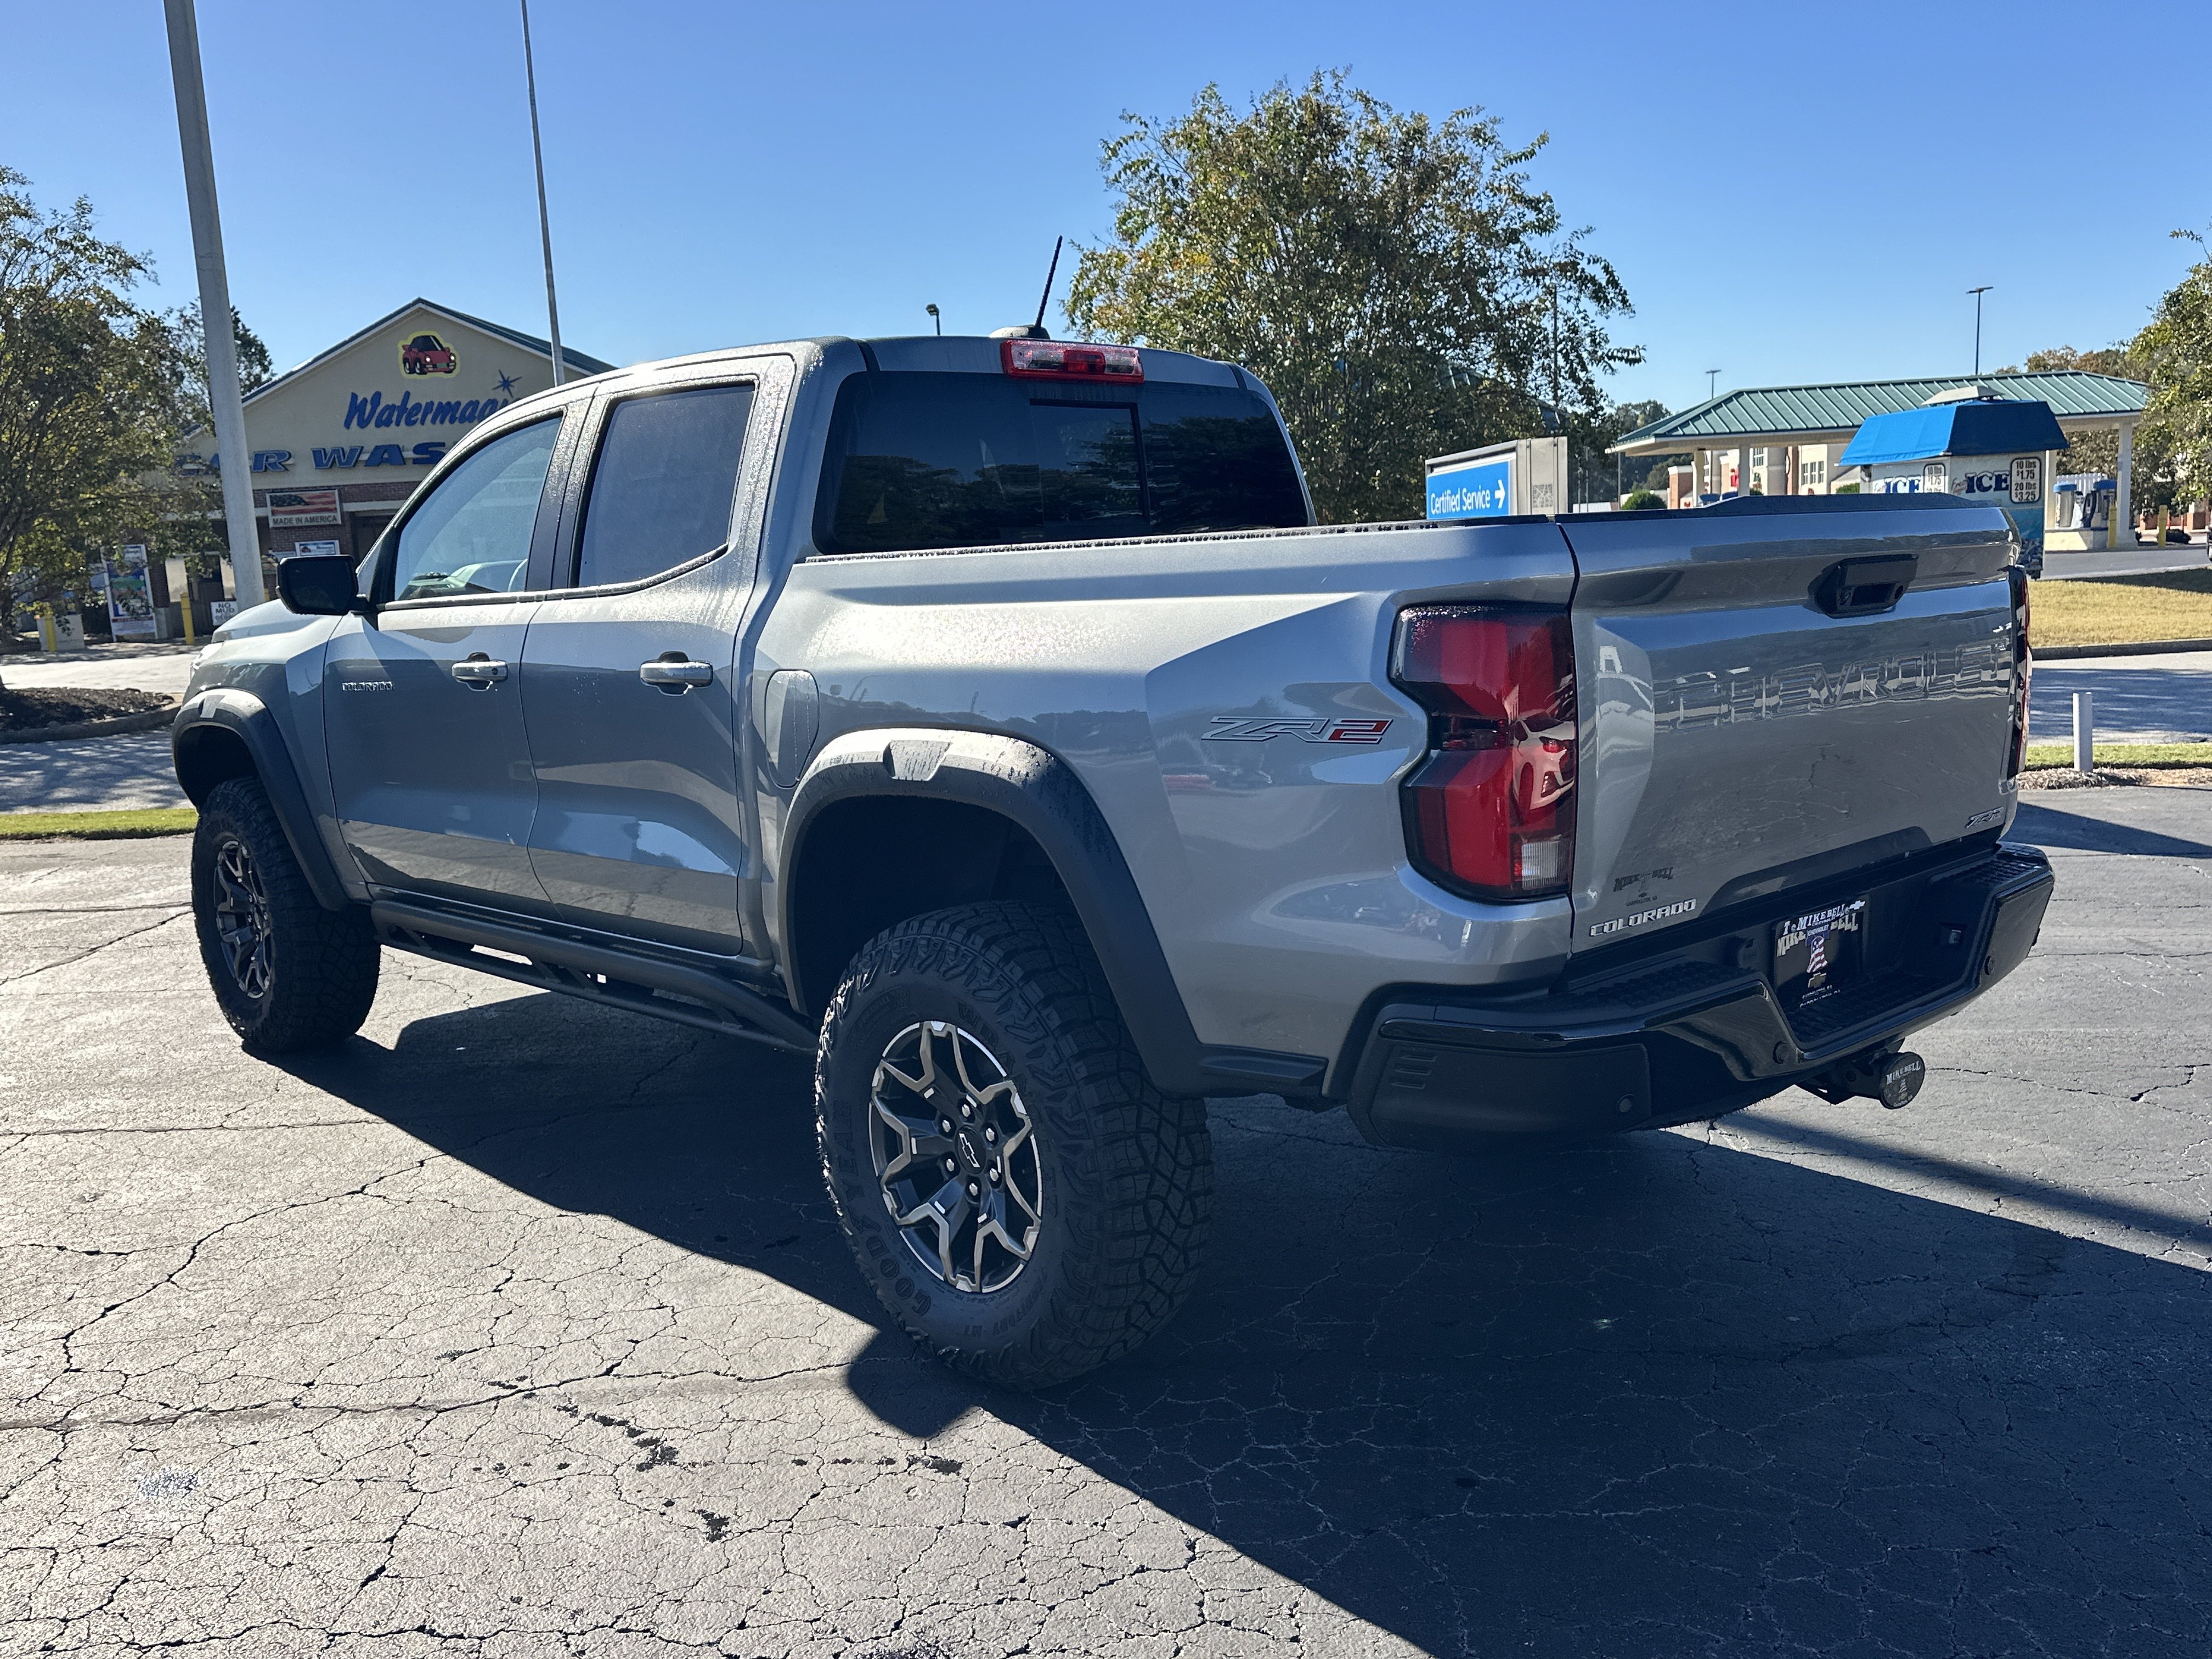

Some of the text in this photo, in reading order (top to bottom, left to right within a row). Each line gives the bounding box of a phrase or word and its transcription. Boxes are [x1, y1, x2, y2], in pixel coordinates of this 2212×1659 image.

[310, 442, 446, 470] WAS
[2016, 460, 2036, 469] 10 lbs
[1884, 475, 1921, 493] ICE
[1965, 470, 2010, 494] ICE
[2017, 470, 2035, 480] $1.75
[2015, 482, 2036, 491] 20 lbs
[1431, 484, 1491, 515] Certified Service
[2015, 491, 2036, 501] $3.25
[273, 517, 293, 526] MADE
[304, 515, 337, 524] AMERICA
[1200, 715, 1394, 745] ZR2
[1590, 899, 1697, 936] COLORADO
